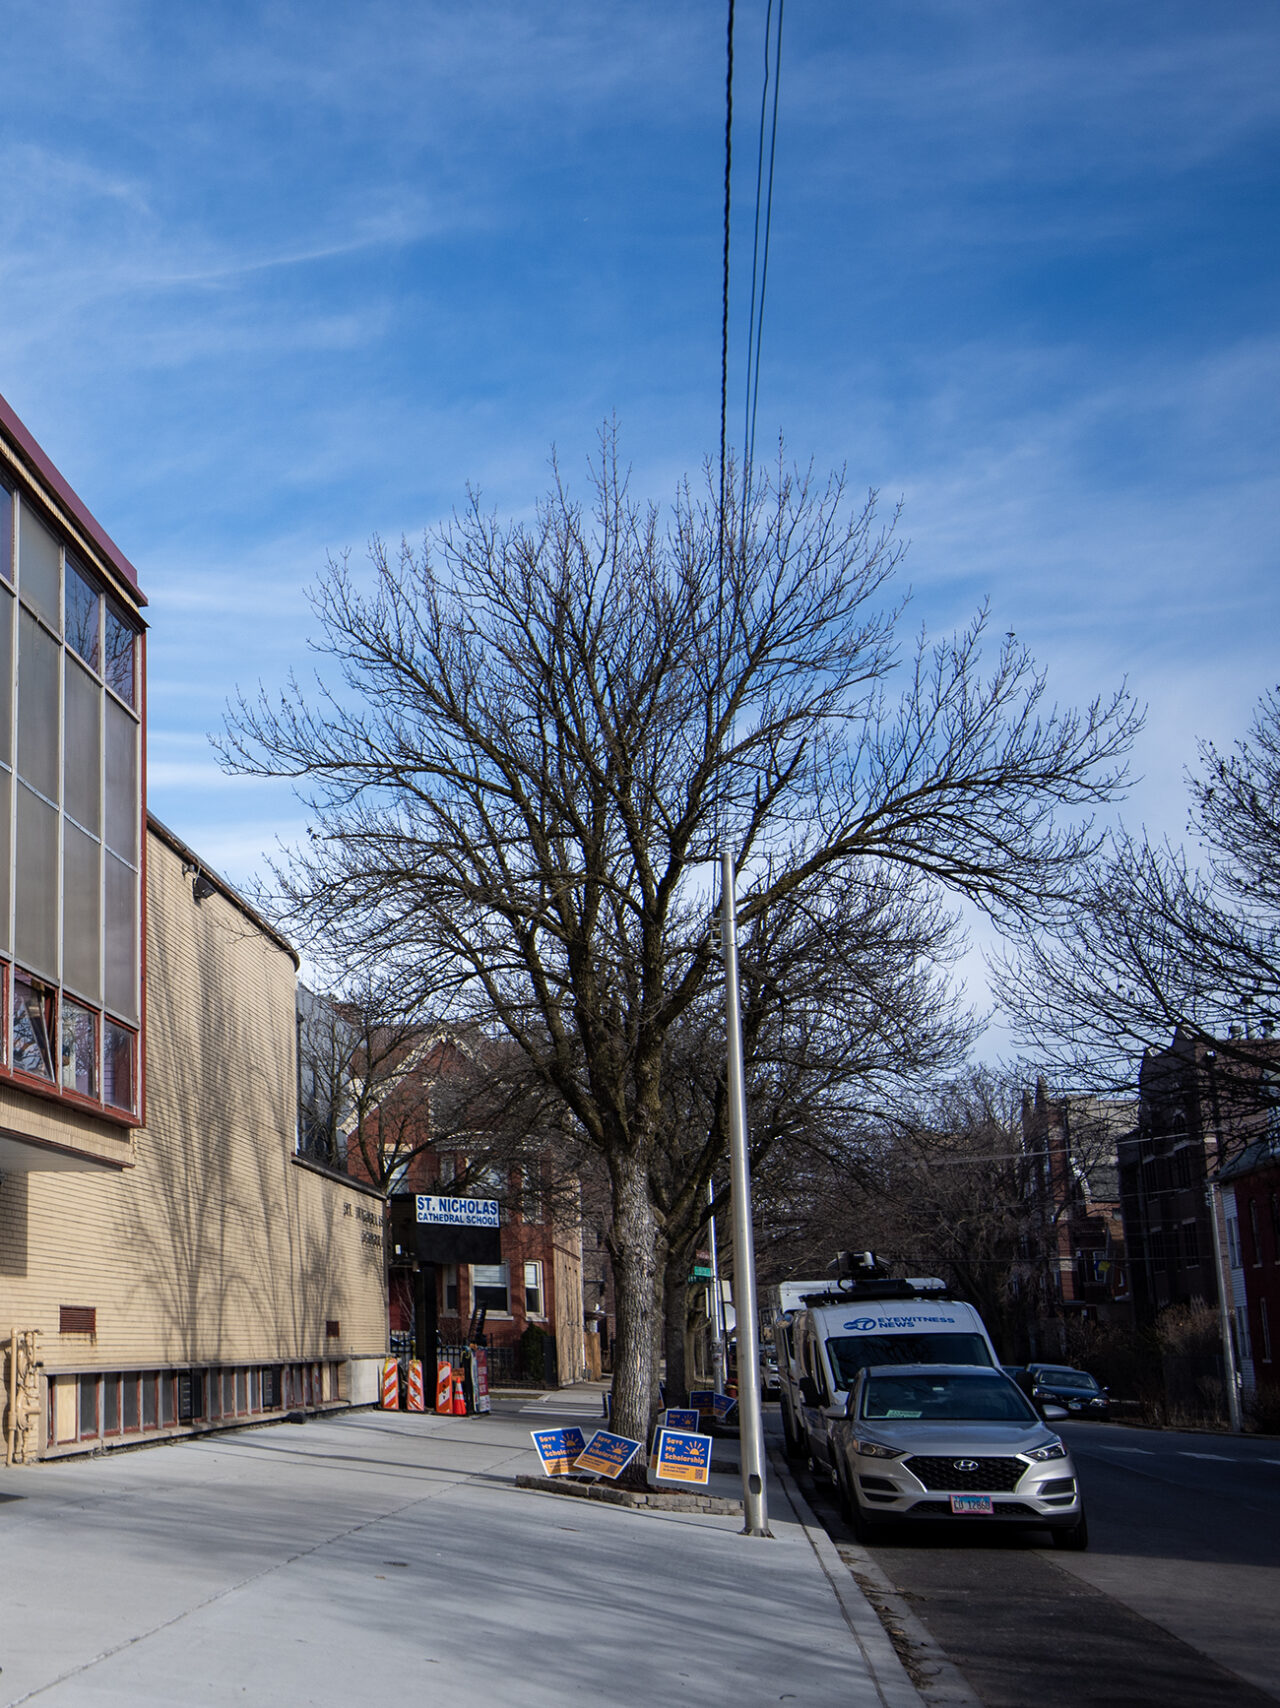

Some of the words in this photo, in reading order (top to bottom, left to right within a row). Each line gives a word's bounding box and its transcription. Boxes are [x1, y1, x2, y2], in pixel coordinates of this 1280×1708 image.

[417, 1196, 435, 1211] ST.
[439, 1198, 497, 1216] NICHOLAS
[417, 1212, 465, 1224] CATHEDRAL
[465, 1215, 498, 1226] SCHOOL
[877, 1316, 956, 1324] EYEWITNESS
[597, 1435, 612, 1444] Save
[666, 1437, 684, 1446] Save
[592, 1441, 602, 1449] My
[665, 1445, 676, 1453] My
[588, 1447, 624, 1464] Scholarship
[664, 1452, 705, 1465] Scholarship
